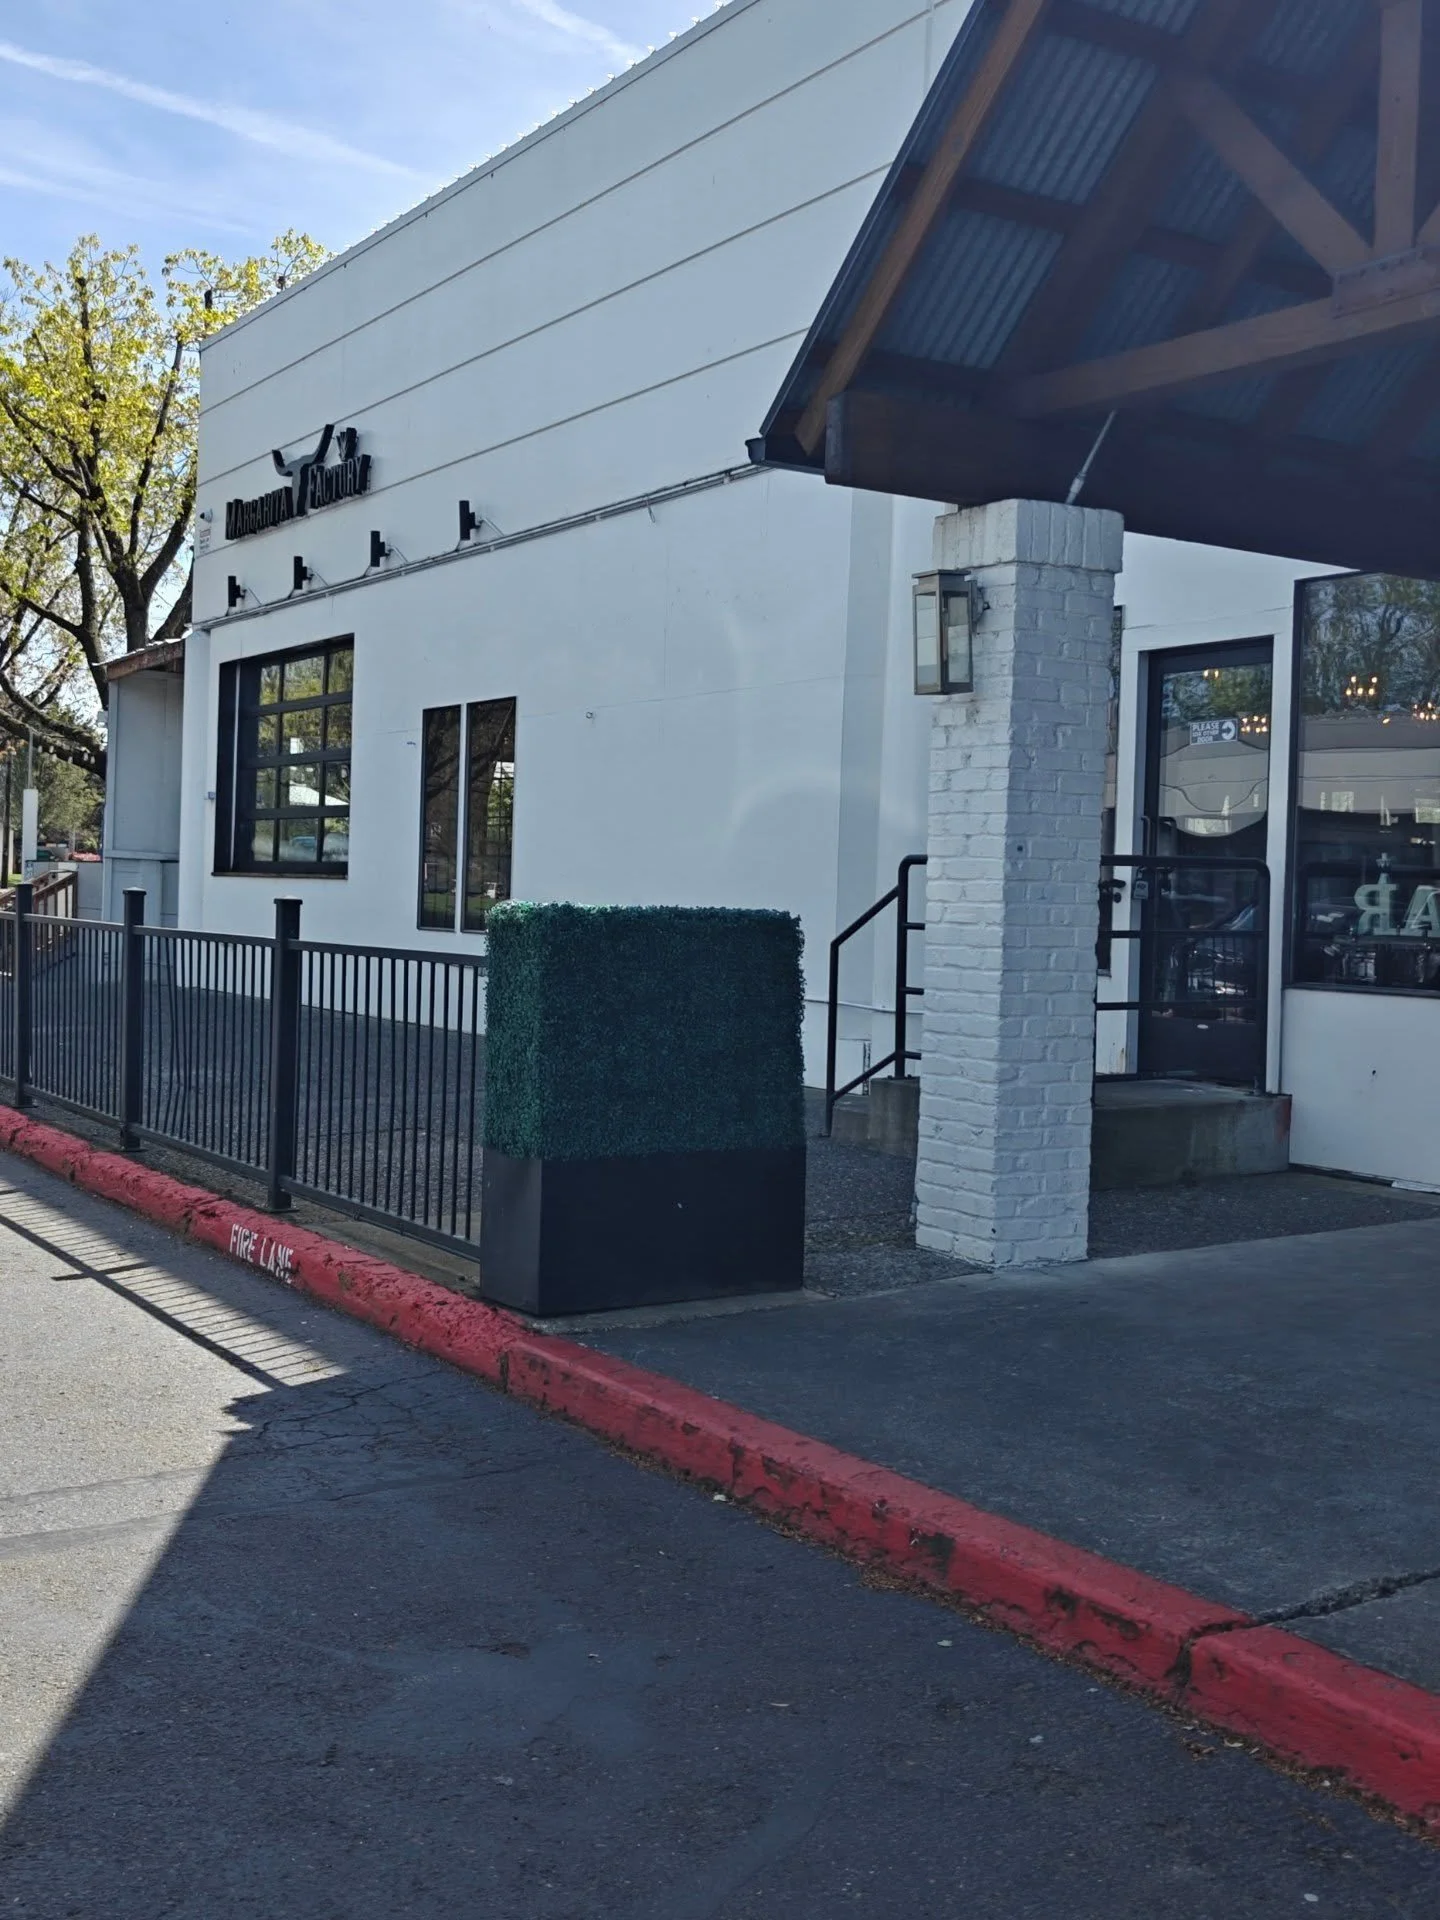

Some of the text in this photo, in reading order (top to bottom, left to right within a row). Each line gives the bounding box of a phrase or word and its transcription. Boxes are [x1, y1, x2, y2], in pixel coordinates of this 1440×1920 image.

[308, 454, 371, 509] FACTORY
[226, 486, 293, 540] MARGARITA
[1192, 721, 1220, 731] PLEASE
[229, 1223, 294, 1284] FIRE LANE
